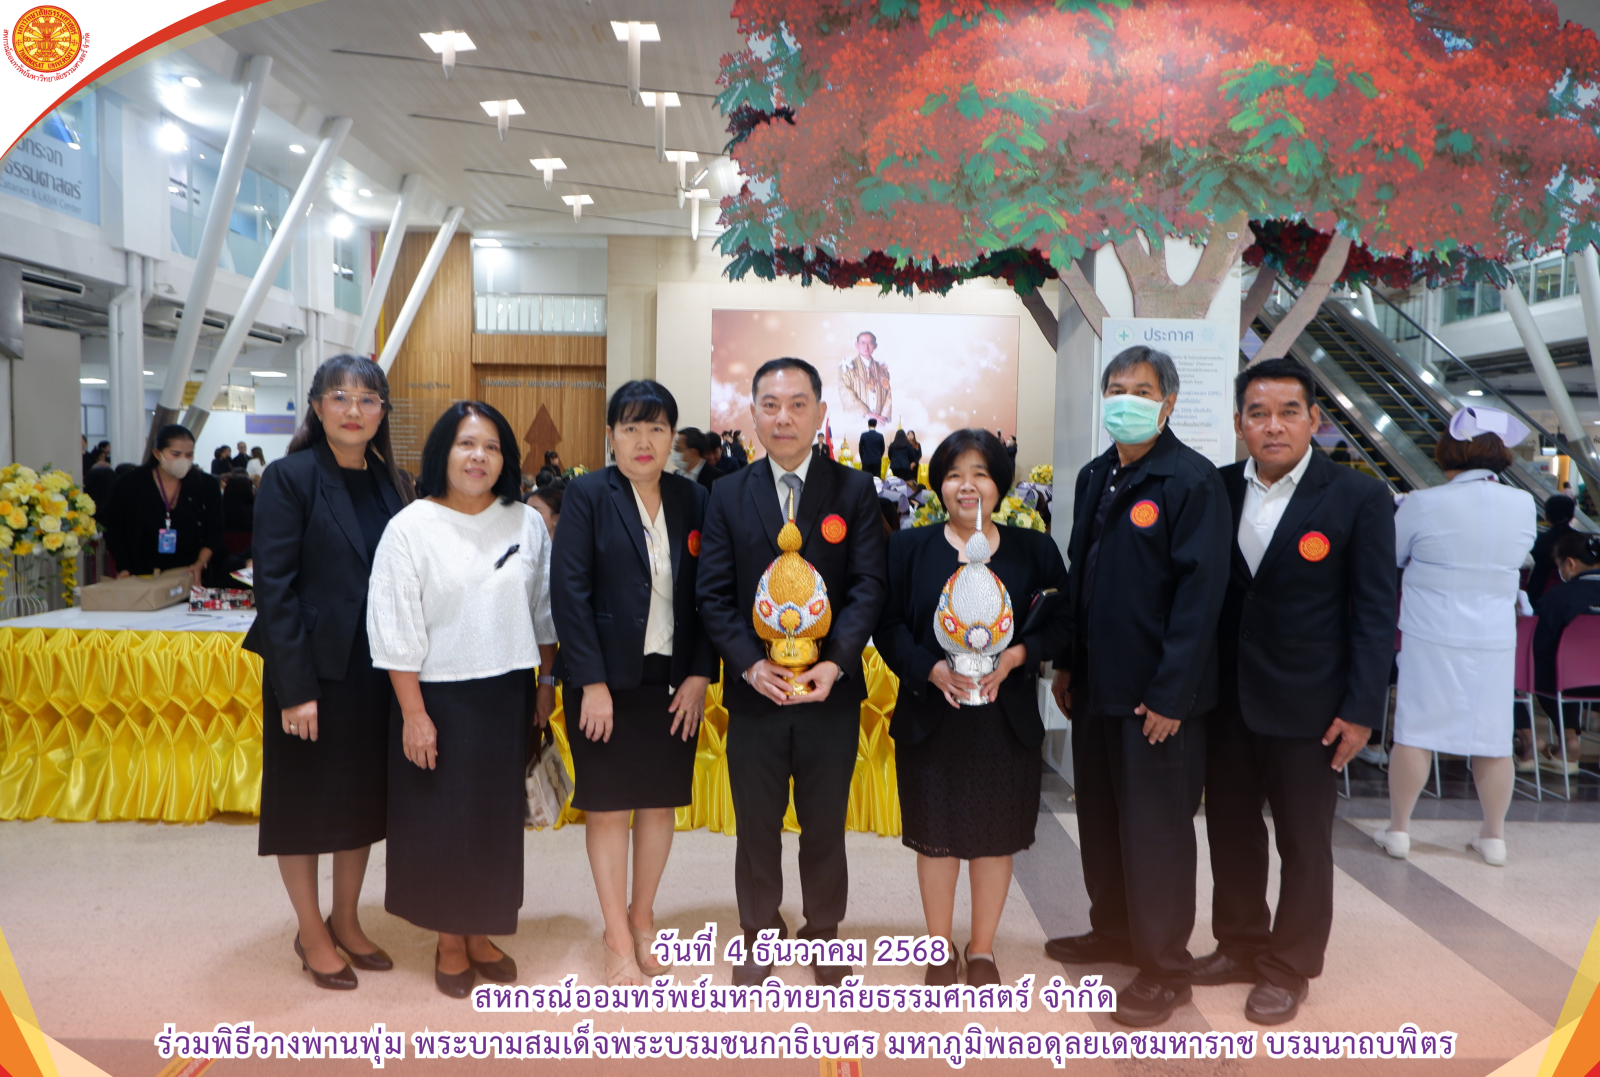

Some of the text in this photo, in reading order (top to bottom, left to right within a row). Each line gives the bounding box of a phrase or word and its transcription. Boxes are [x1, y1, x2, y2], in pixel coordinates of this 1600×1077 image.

[59, 198, 82, 214] Center
[1143, 327, 1194, 341] ประกาศ
[479, 378, 606, 389] THAMMASAT UNIVERSITY HOSPITAL
